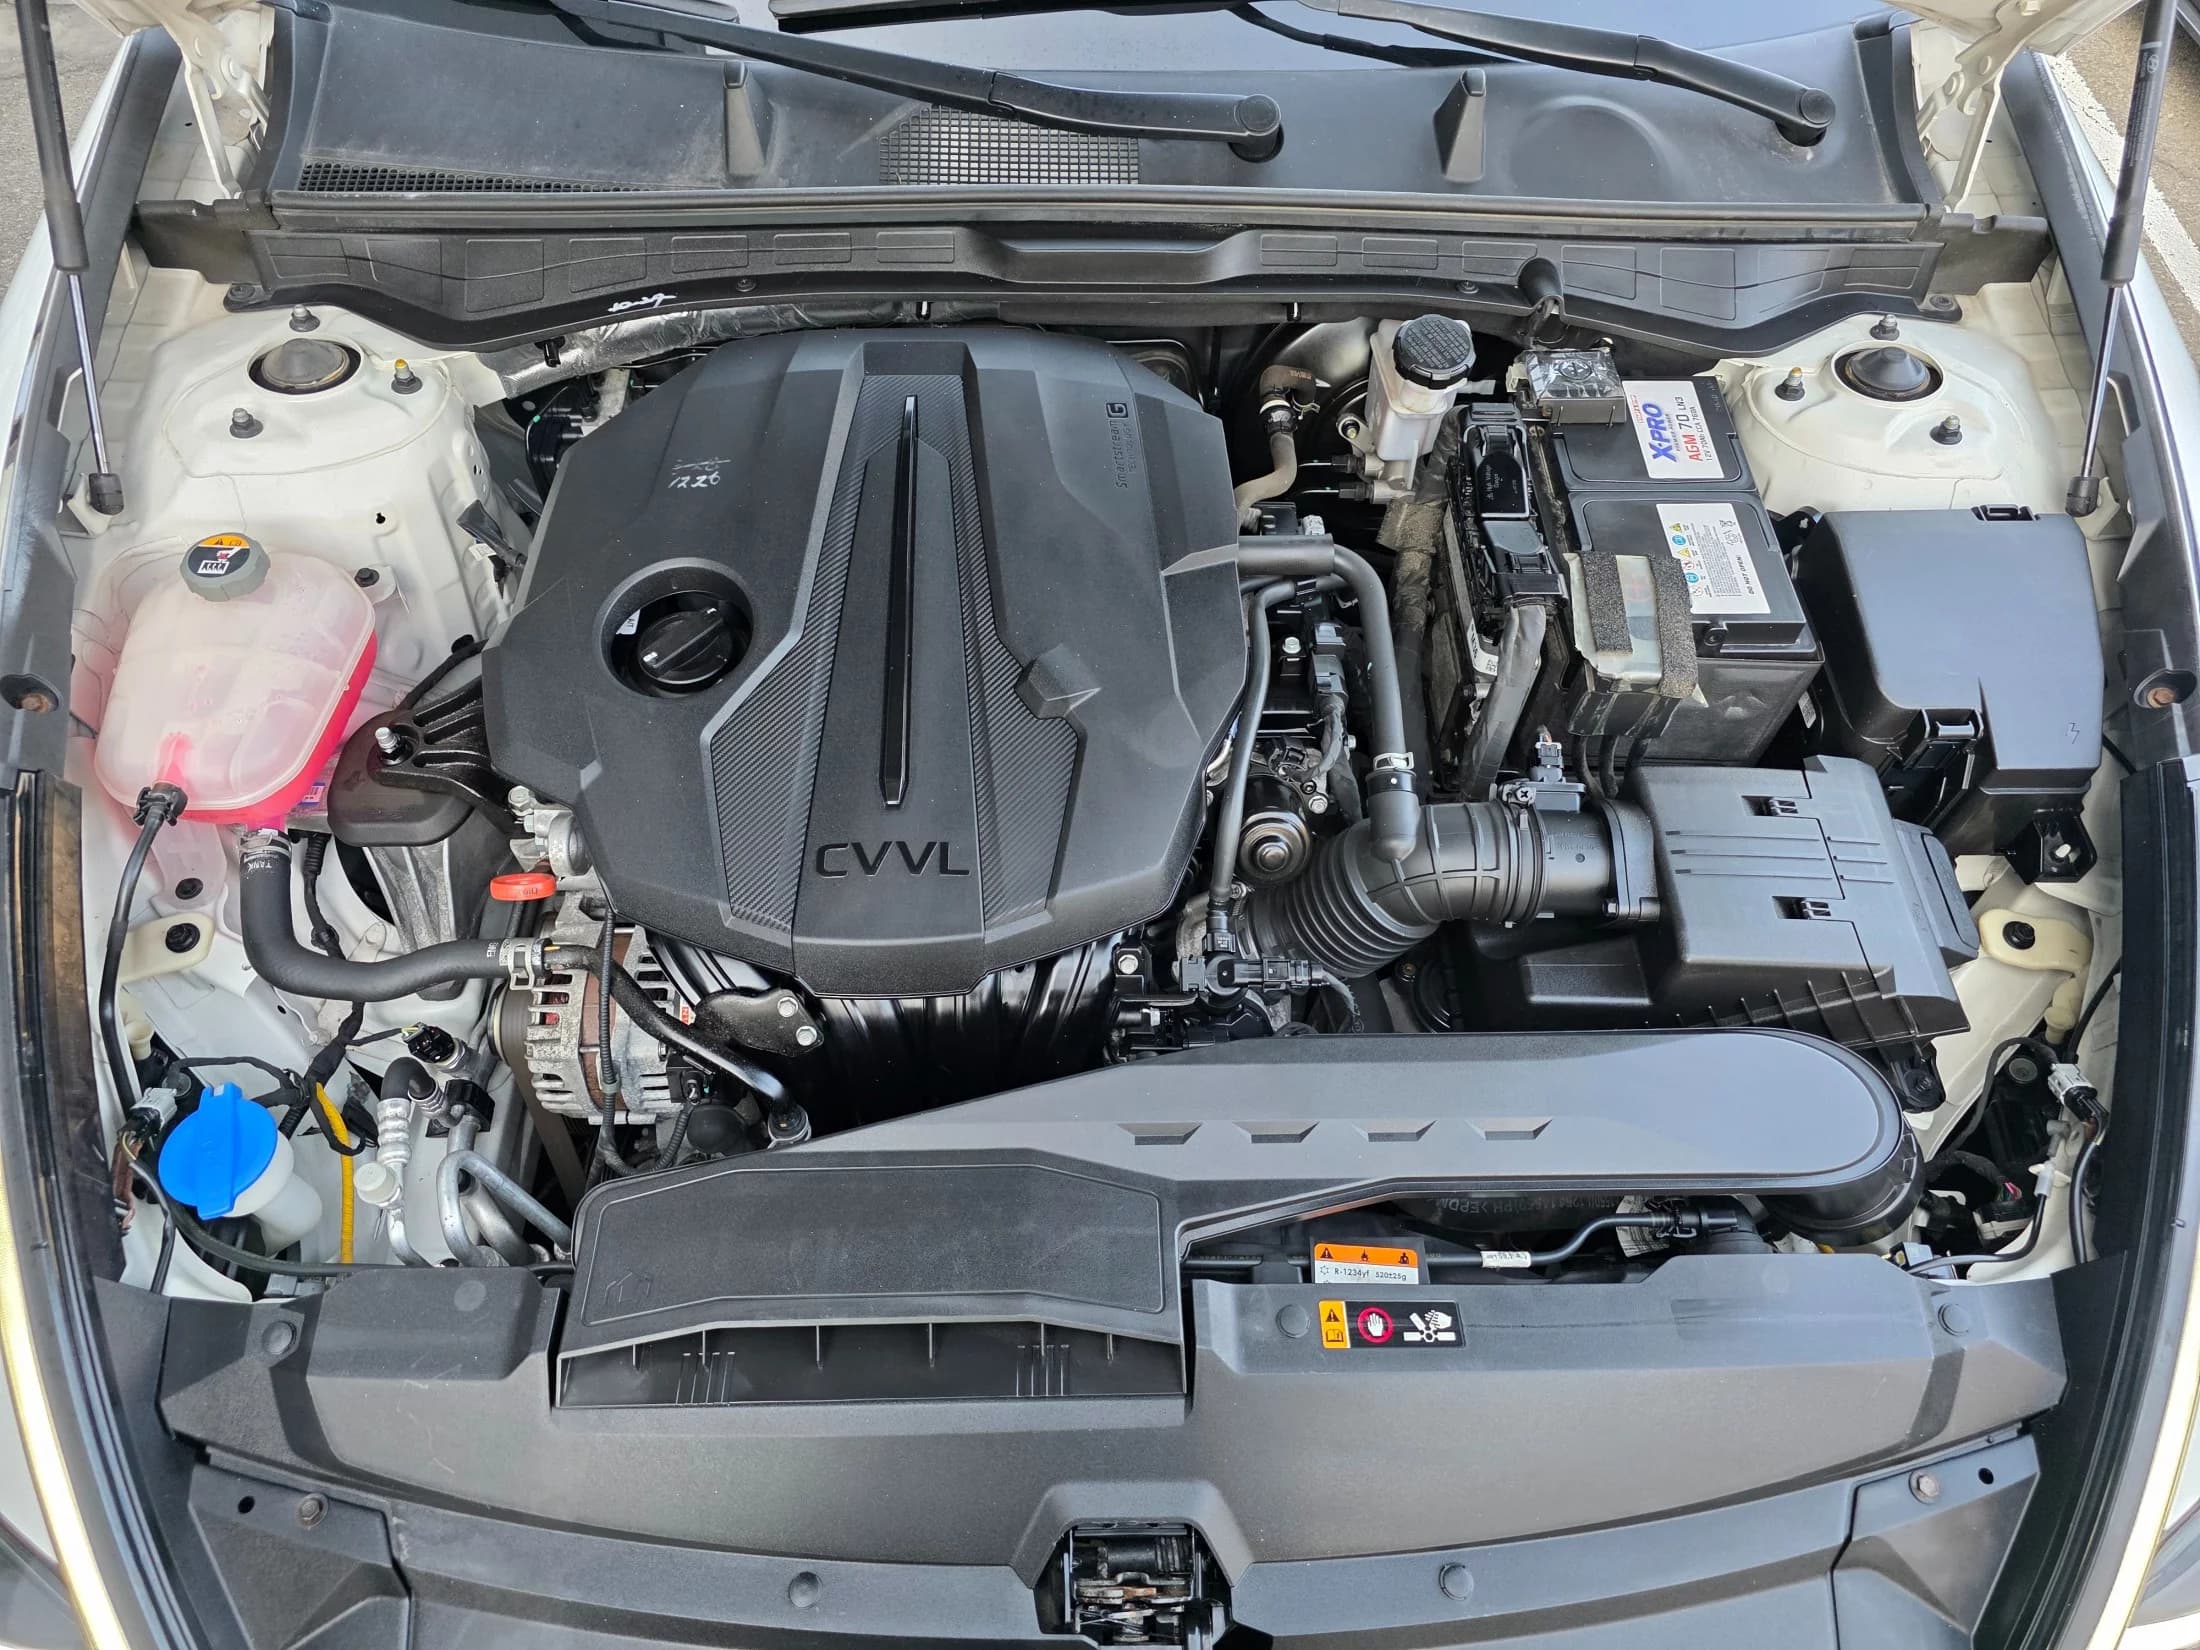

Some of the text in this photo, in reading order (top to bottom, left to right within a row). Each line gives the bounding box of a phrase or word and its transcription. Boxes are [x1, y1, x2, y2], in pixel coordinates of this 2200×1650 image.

[1674, 396, 1703, 461] AGM 70 LN3
[1109, 420, 1128, 489] Smartstream
[1741, 573, 1751, 585] NOT
[1746, 586, 1755, 595] DO
[815, 841, 971, 878] CVVL
[1334, 1268, 1407, 1281] R-1234yf 520±25g
